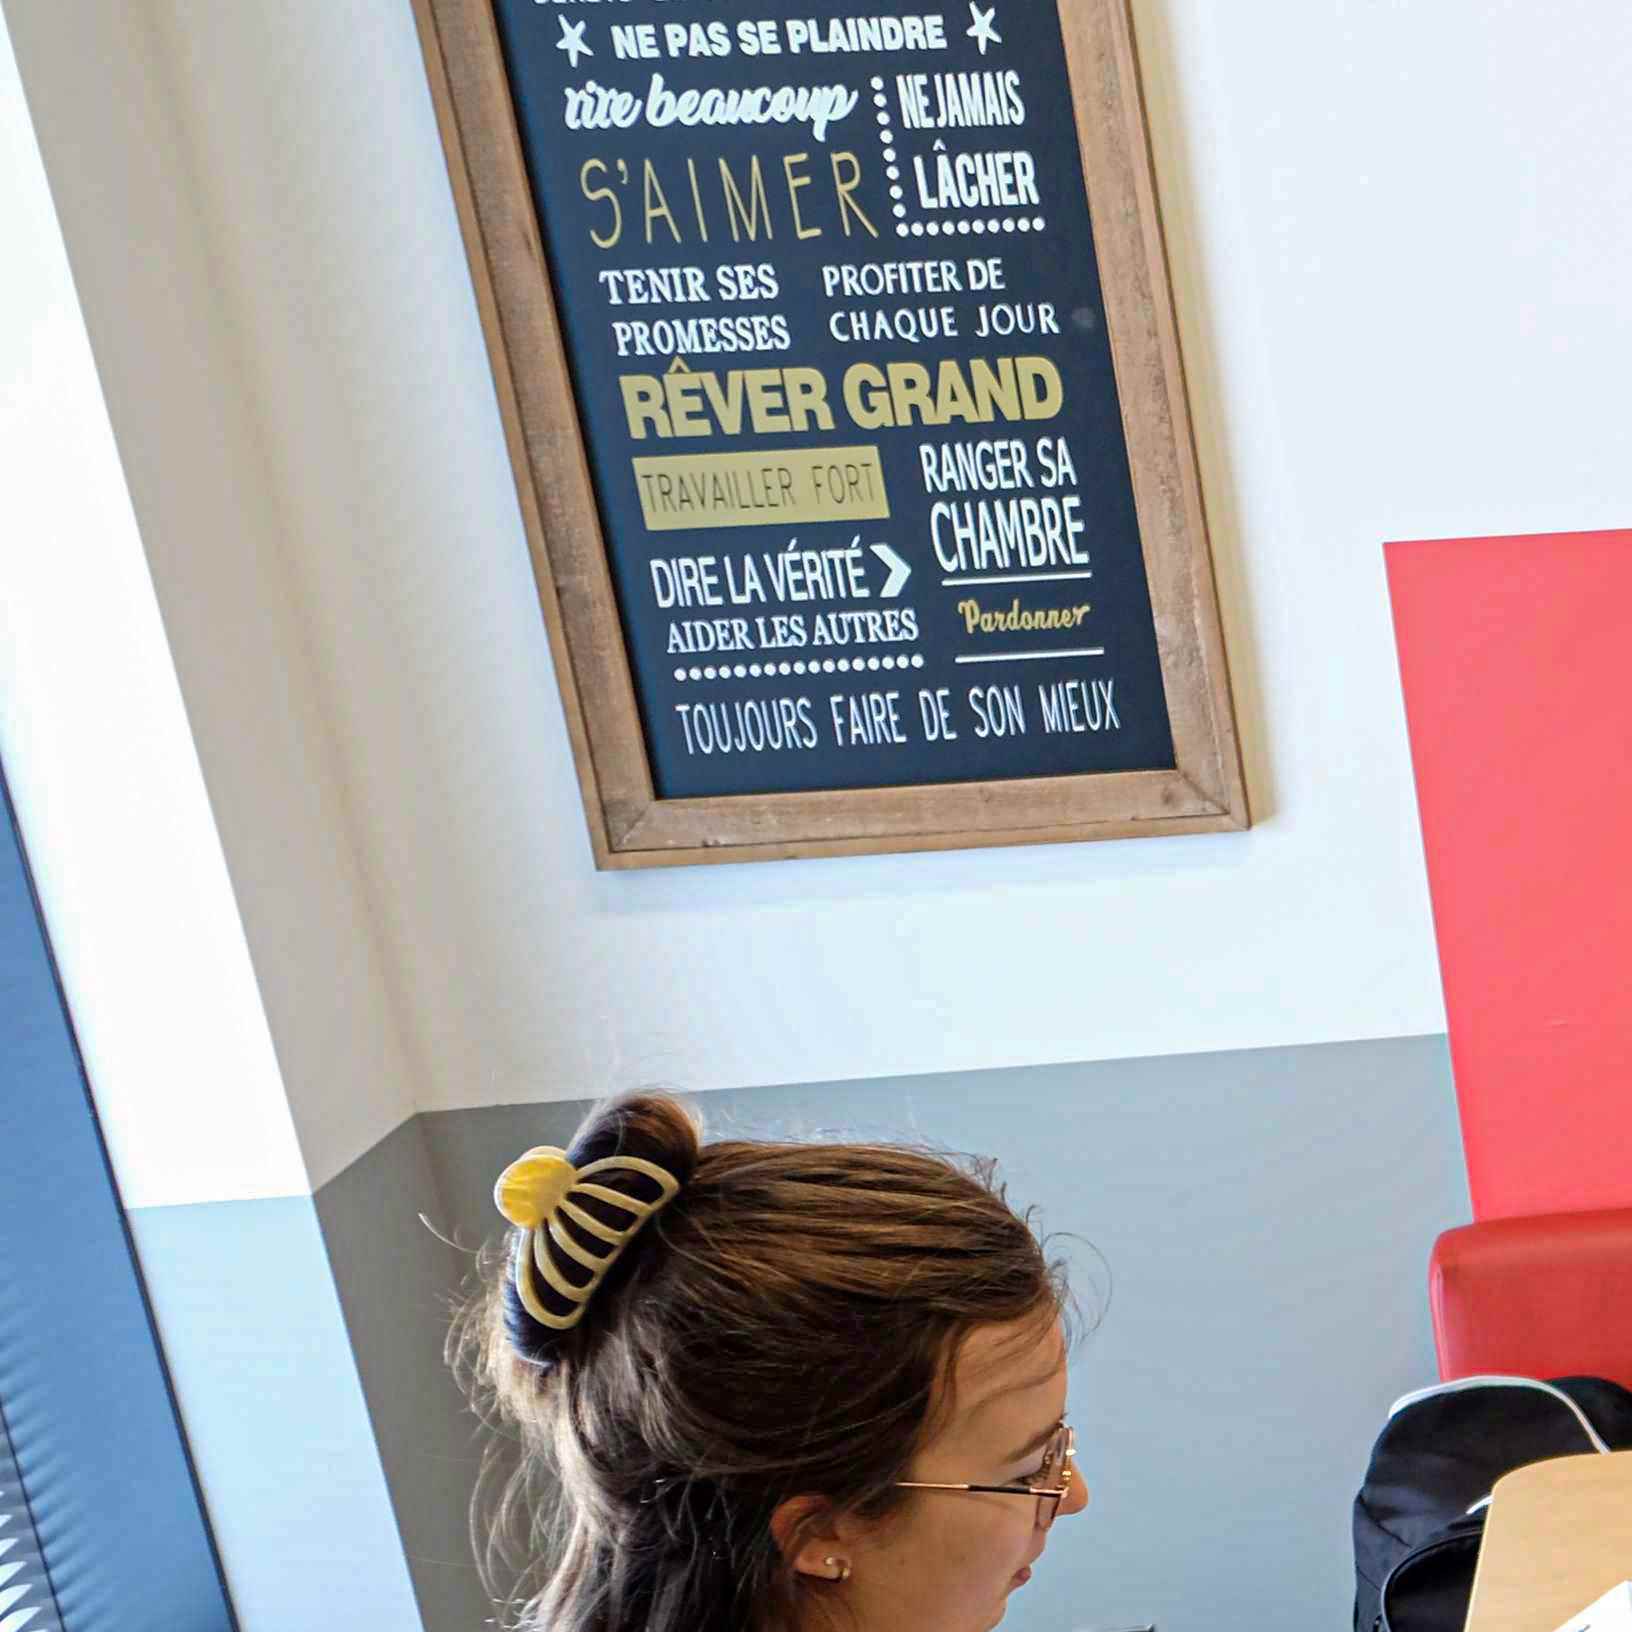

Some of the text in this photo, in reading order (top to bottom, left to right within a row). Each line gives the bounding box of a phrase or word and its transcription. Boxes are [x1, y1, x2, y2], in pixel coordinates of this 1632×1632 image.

[611, 15, 947, 60] NE PAS SE PLAINDRE
[645, 72, 859, 142] beaucoup
[895, 70, 1026, 131] NE JAMAIS
[913, 138, 1040, 212] LÂCHER
[598, 262, 780, 306] TENIR SES
[821, 257, 1005, 299] PROFITER DE
[611, 313, 791, 359] PROMESSES
[829, 302, 1062, 344] CHAQUE JOUR
[618, 355, 1064, 441] RÊVER GRAND
[639, 461, 878, 514] TRAVAILLER FORT
[919, 436, 1077, 494] RANGER SA
[928, 496, 1090, 574] CHAMBRE
[649, 534, 871, 610] DIRE LA VÉRITÉ
[666, 607, 920, 655] AIDER LES AUTRES
[957, 597, 1091, 635] Pardonner
[675, 678, 1122, 756] TOUJOURS FAIRE DE SON MIEUX
